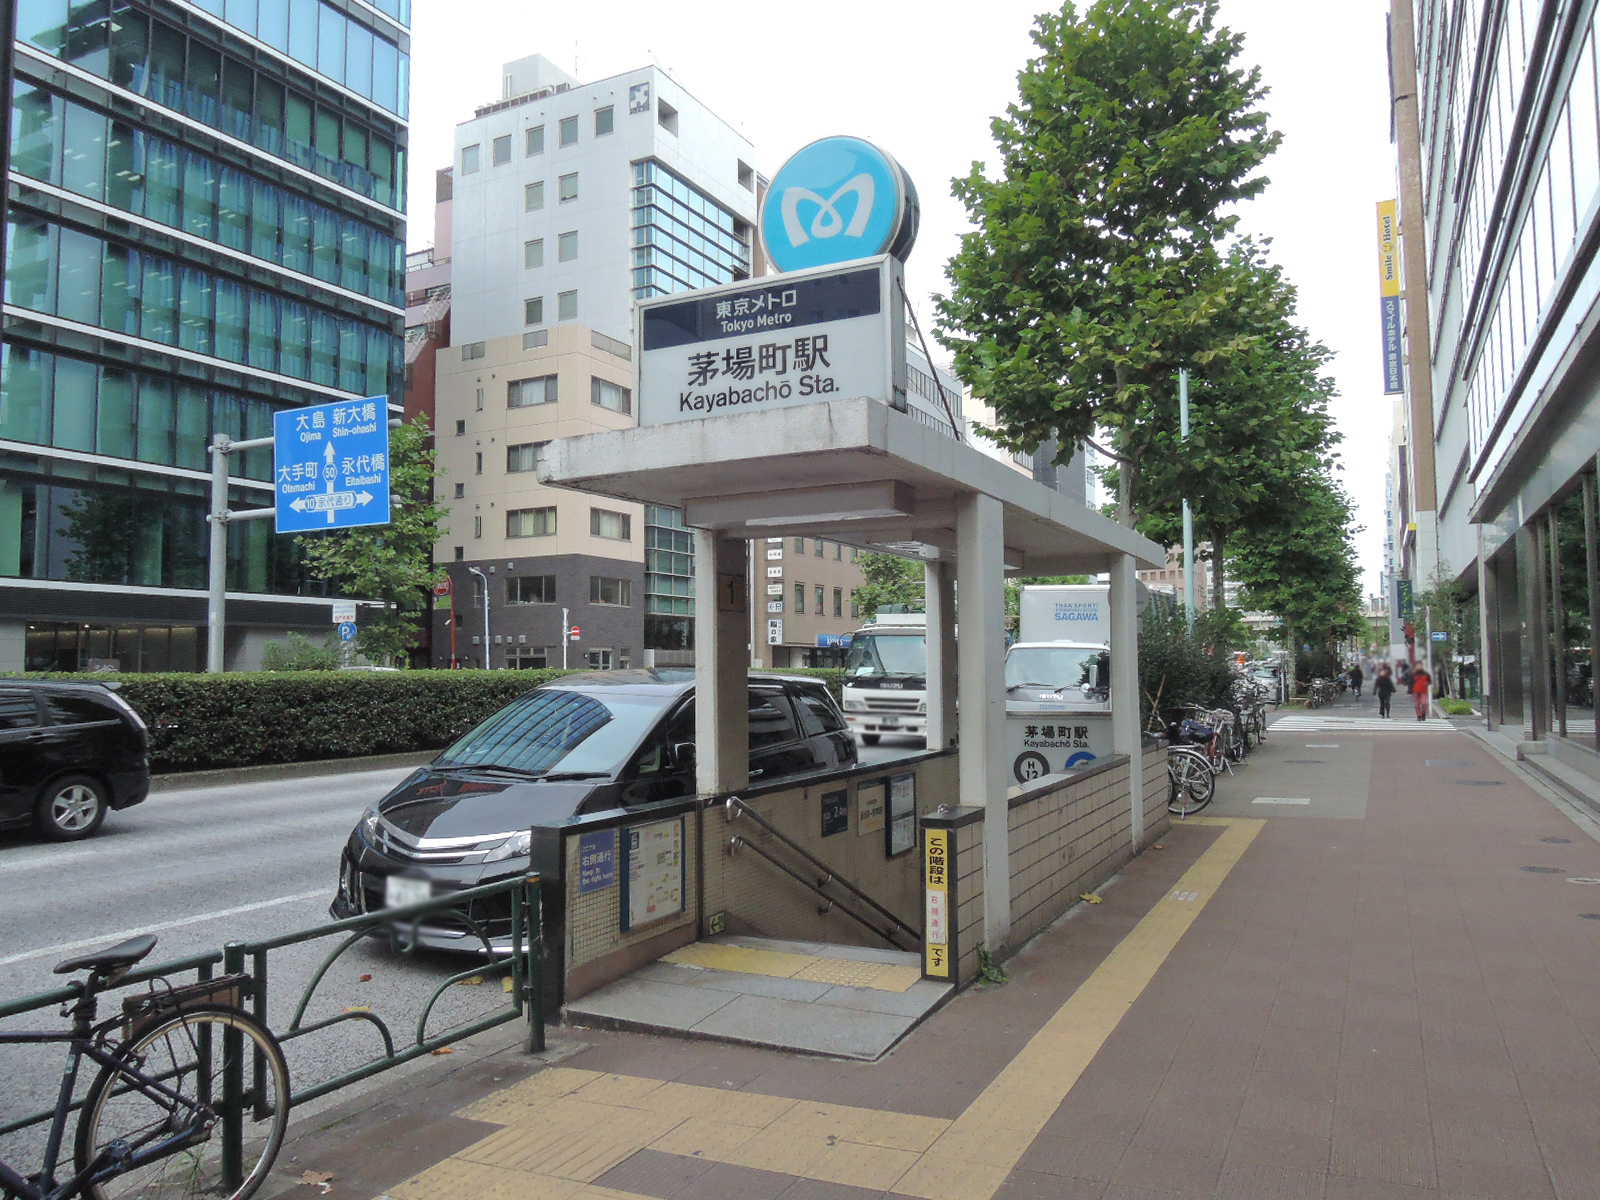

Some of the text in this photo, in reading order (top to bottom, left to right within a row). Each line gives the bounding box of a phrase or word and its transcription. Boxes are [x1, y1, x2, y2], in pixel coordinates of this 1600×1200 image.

[1383, 215, 1394, 281] Smile Hotel
[716, 290, 797, 320] 東京メトロ
[720, 312, 792, 333] Tokyo Metro
[1386, 300, 1397, 351] スマイルホテル
[687, 334, 831, 387] 茅場町駅
[679, 375, 840, 412] Kayabachō Sta.
[296, 411, 324, 431] 大島
[333, 402, 376, 425] 新大橋
[300, 432, 321, 443] Ojima
[333, 422, 377, 438] Shin-ohashi
[278, 462, 318, 483] 大手町
[325, 467, 335, 478] 50
[342, 453, 385, 475] 永代橋
[282, 481, 315, 494] Otemachi
[307, 494, 353, 509] 10 永代通り
[1055, 612, 1099, 621] SAGAWA
[342, 626, 350, 640] P
[1025, 725, 1088, 739] 茅場町駅
[1073, 739, 1090, 748] Sta.
[1025, 769, 1039, 779] 12
[1027, 761, 1035, 769] H
[582, 850, 612, 867] 右側通行
[929, 837, 944, 885] この階段は
[931, 948, 944, 967] です
